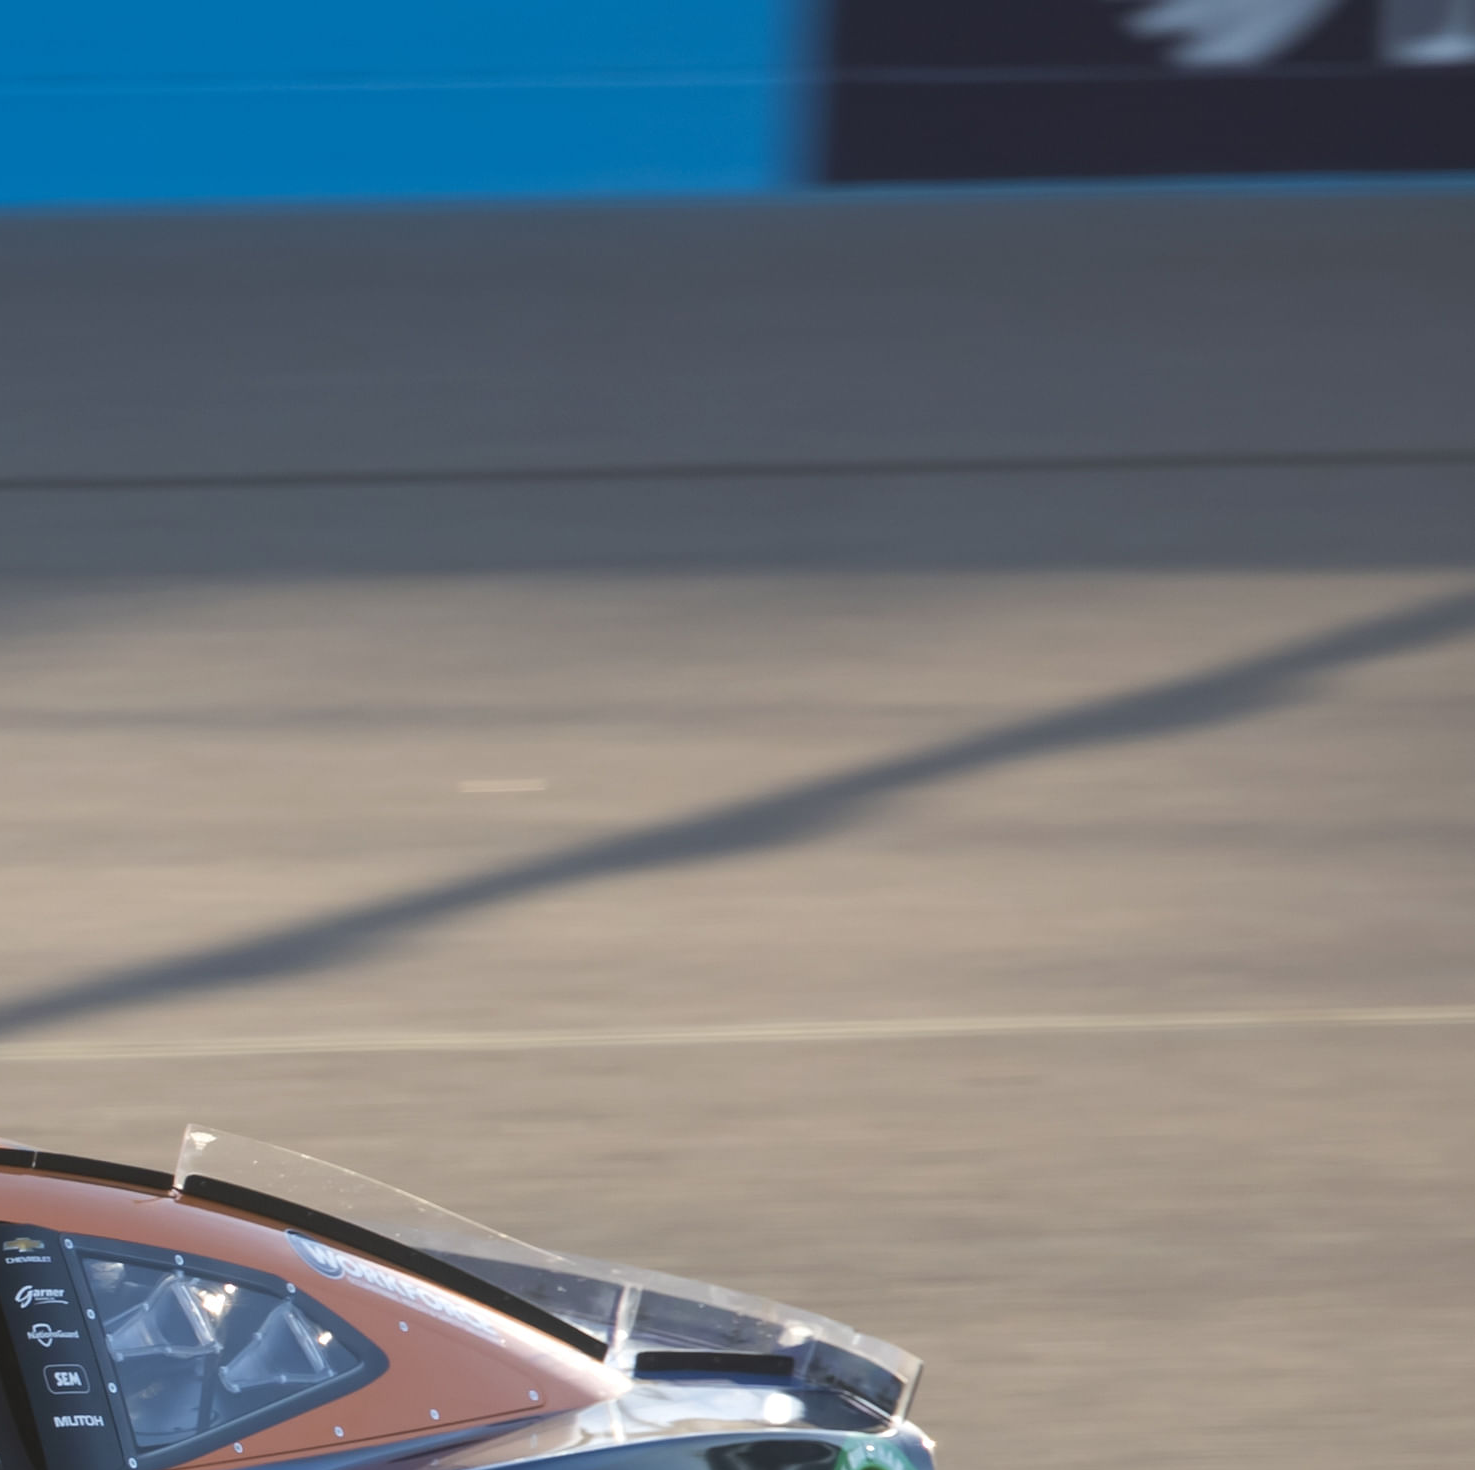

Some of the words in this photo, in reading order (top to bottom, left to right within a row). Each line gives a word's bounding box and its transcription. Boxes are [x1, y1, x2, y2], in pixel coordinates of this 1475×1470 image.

[14, 1284, 66, 1309] Garner
[53, 1371, 83, 1388] SEM
[52, 1414, 105, 1429] MUTOH
